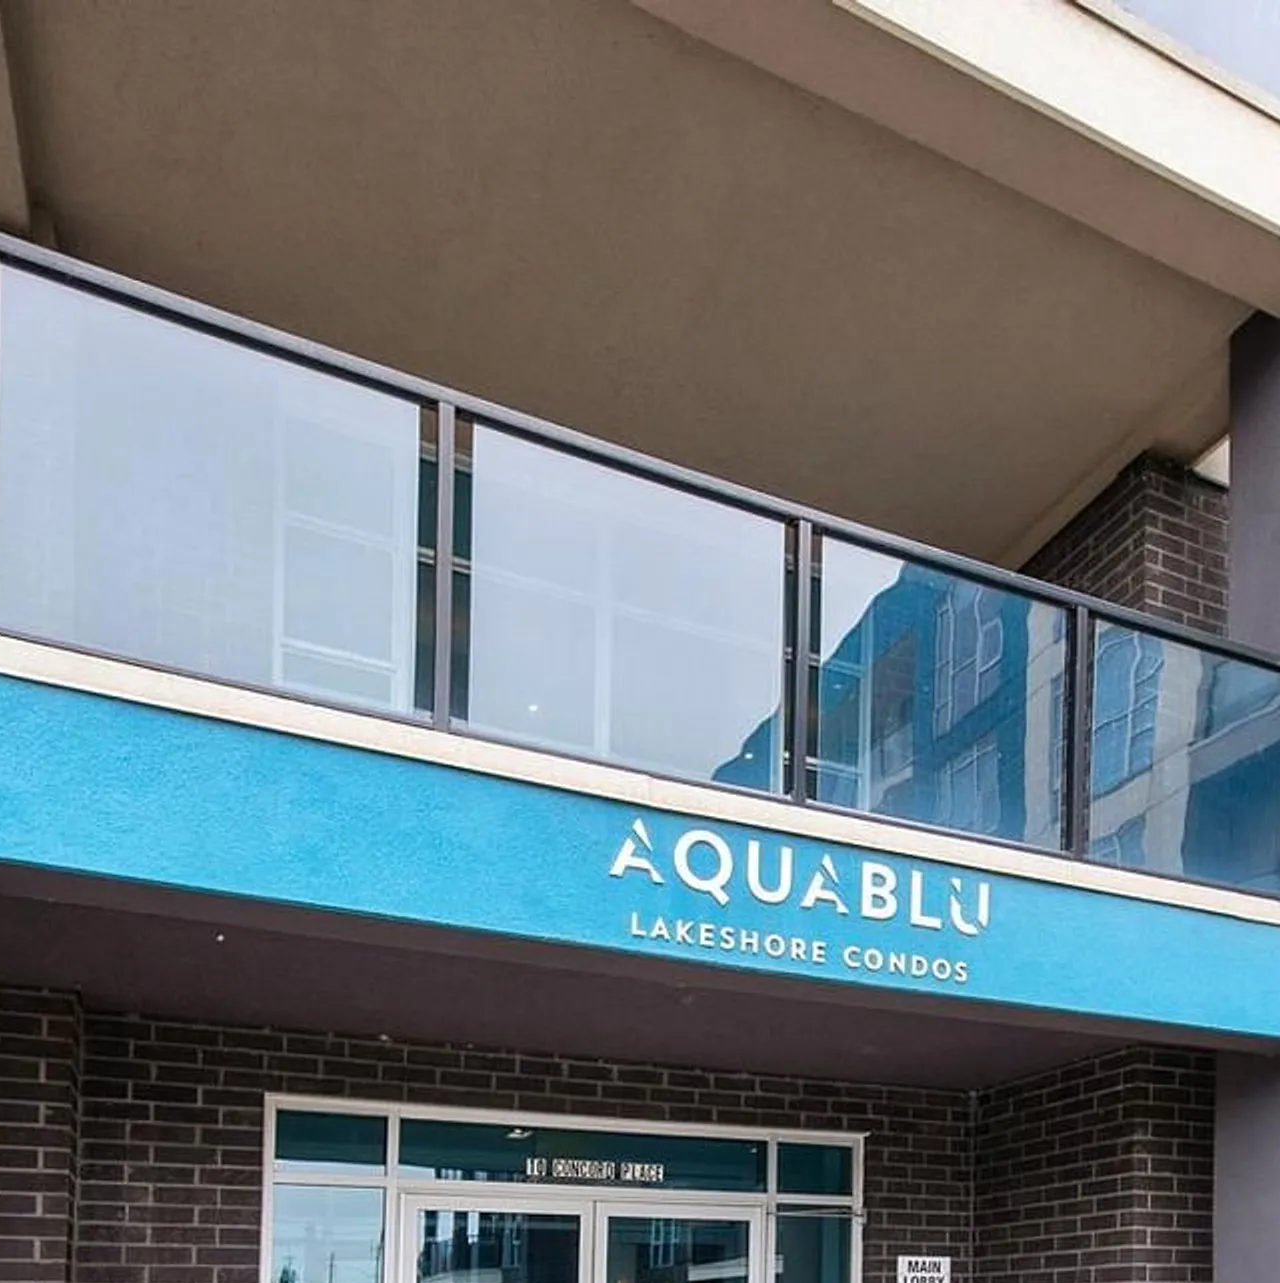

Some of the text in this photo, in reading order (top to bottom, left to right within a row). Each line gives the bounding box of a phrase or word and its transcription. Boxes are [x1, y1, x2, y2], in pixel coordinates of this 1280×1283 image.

[608, 817, 991, 936] AQUABLU
[630, 911, 969, 983] LAKESHORE CONDOS
[526, 1157, 664, 1183] 10 CONCORD PLACE
[908, 1260, 941, 1273] MAIN
